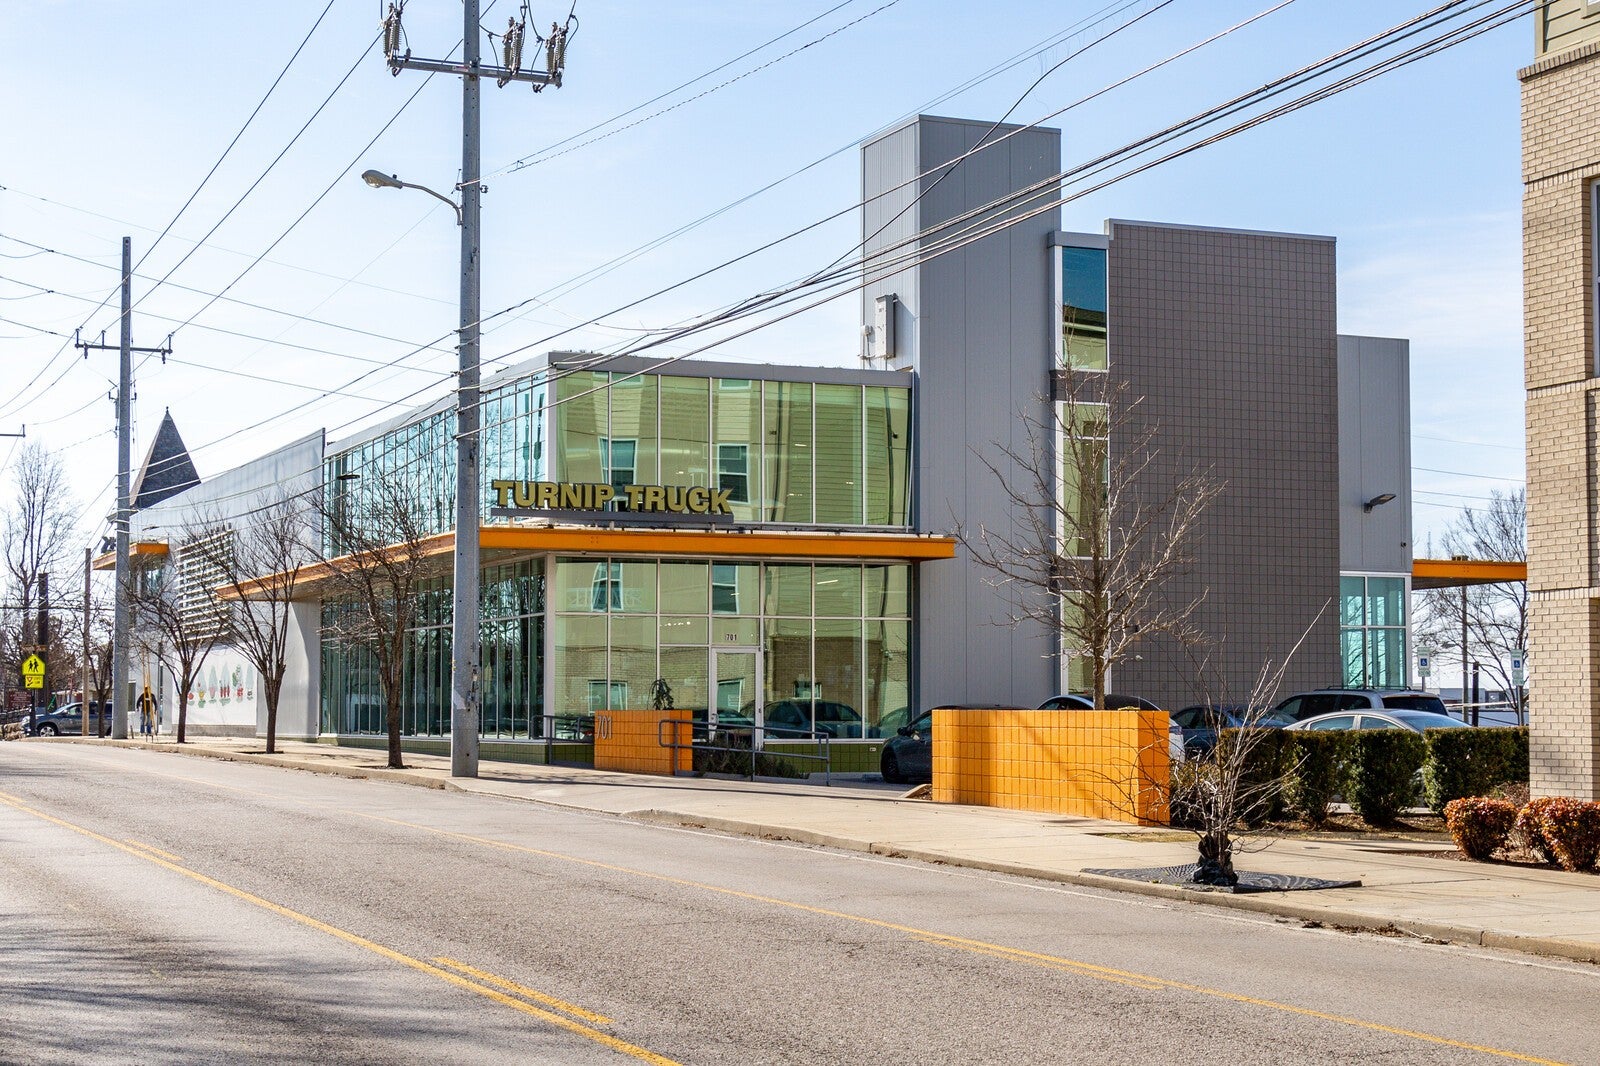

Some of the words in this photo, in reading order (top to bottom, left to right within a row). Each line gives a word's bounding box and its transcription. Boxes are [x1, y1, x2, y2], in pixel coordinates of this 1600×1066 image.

[492, 480, 615, 509] TURNIP
[625, 485, 734, 514] TRUCK
[725, 633, 737, 641] 701
[597, 715, 612, 739] 701
